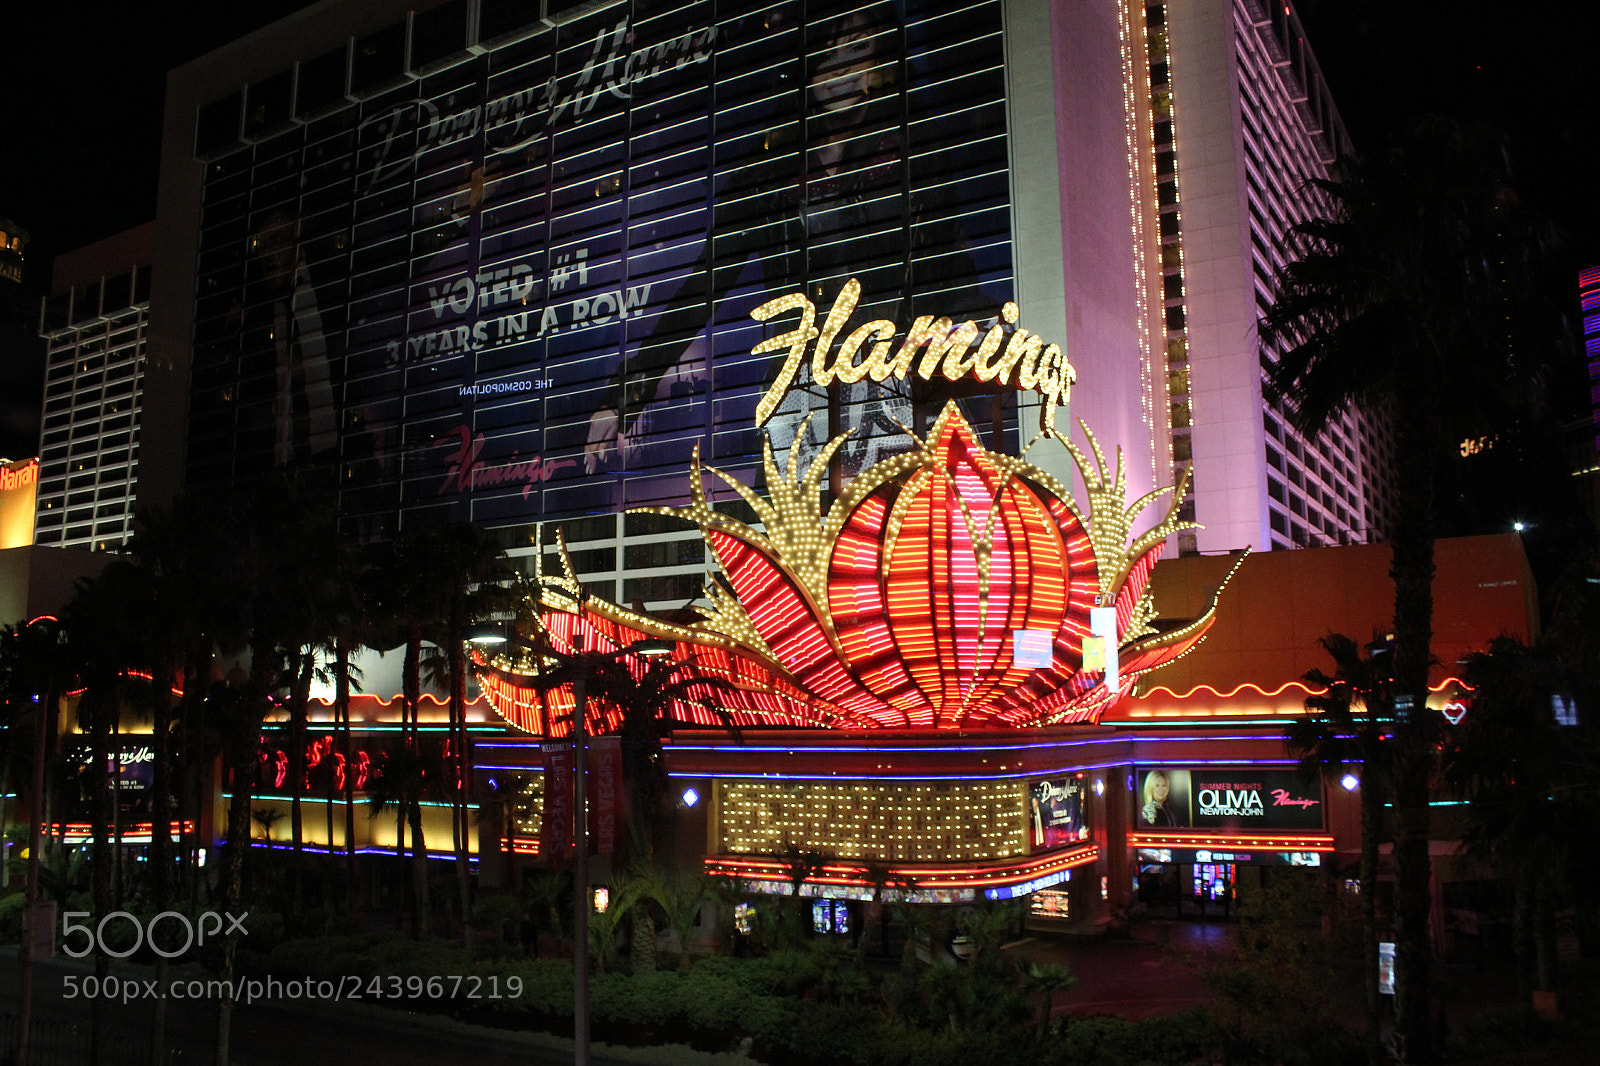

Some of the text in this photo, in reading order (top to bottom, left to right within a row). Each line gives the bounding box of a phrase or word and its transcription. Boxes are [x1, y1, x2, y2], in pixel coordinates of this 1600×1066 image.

[358, 86, 541, 195] Donny
[546, 14, 718, 127] Marie
[428, 248, 589, 319] VOTED #1
[385, 284, 651, 368] 3 YEARS IN A ROW
[750, 277, 1076, 438] Flamingo
[433, 424, 577, 501] Flamingo
[1198, 789, 1263, 808] OLIVIA
[1200, 783, 1262, 791] SUMMER NIGHTS
[1200, 808, 1264, 816] NEWTON-JOHN
[1270, 788, 1320, 810] Flamingo
